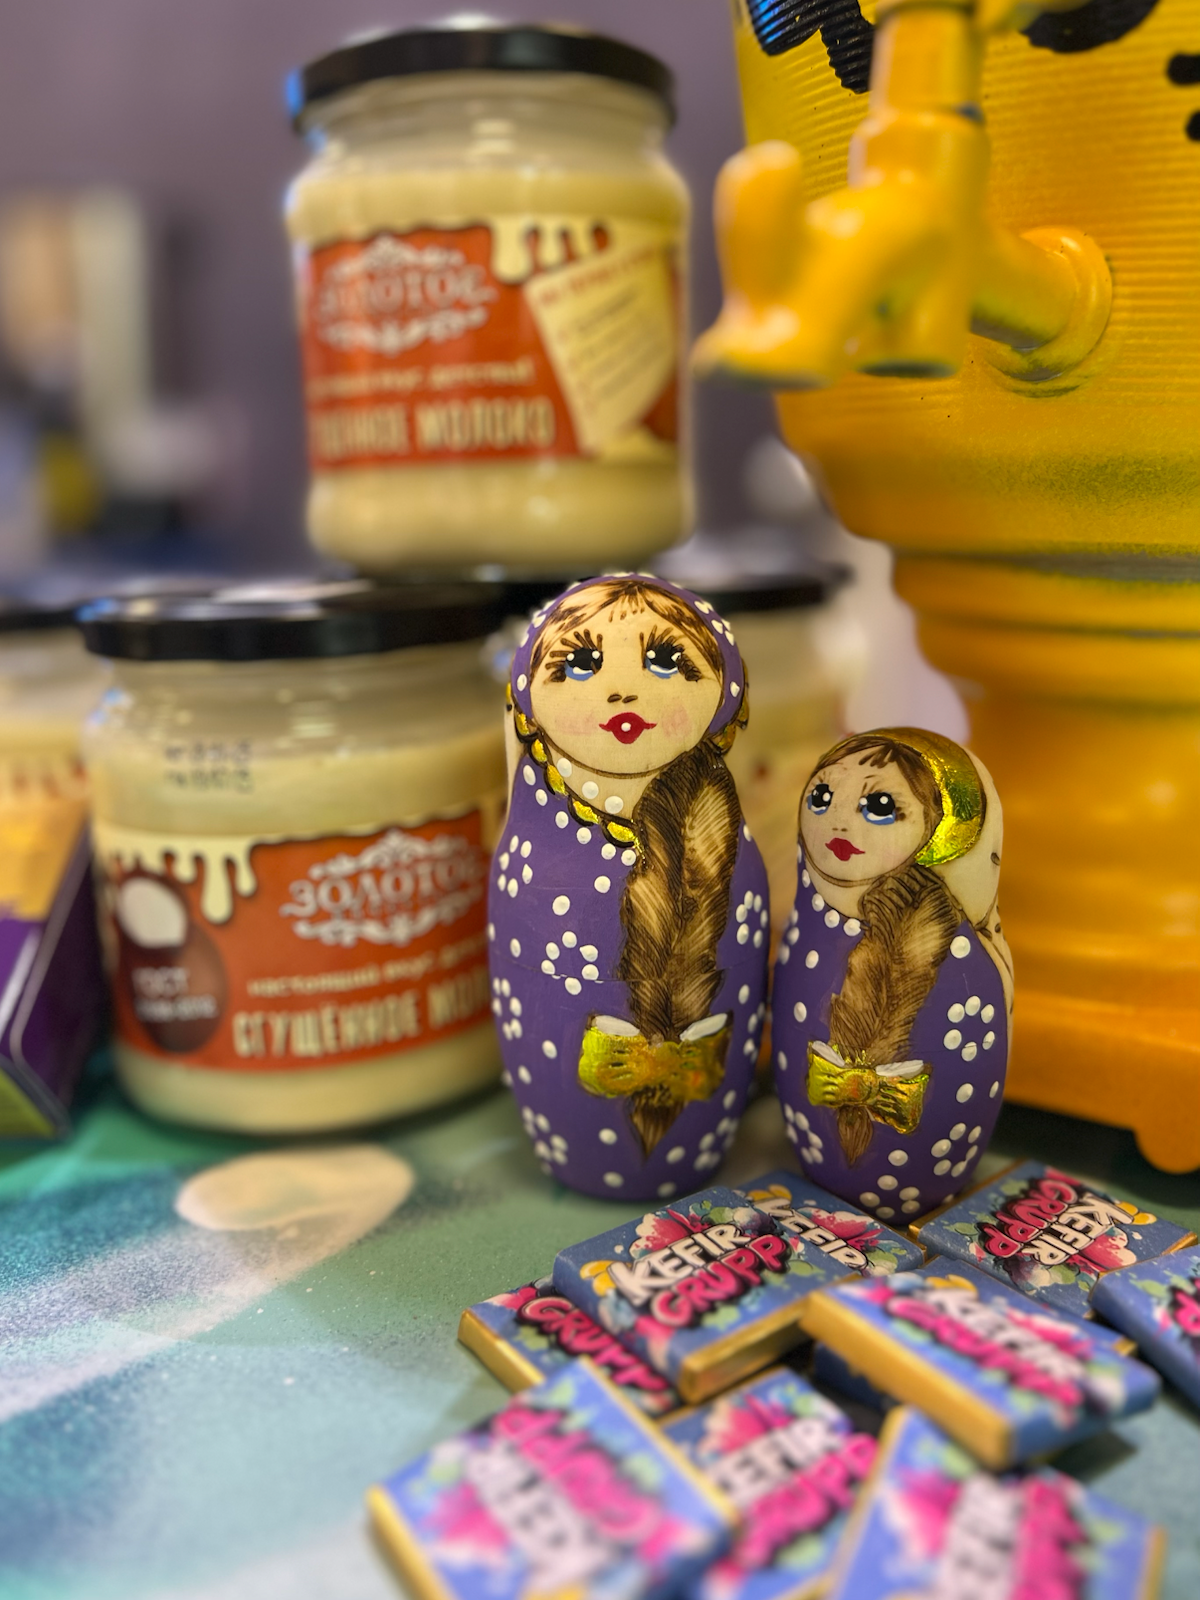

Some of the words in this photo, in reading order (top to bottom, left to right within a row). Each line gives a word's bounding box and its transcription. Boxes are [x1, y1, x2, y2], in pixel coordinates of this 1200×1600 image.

[984, 1178, 1078, 1258] GRUPP
[1020, 1192, 1136, 1266] KEFIR
[607, 1223, 752, 1307] KEFIR
[651, 1234, 792, 1328] GRUPP
